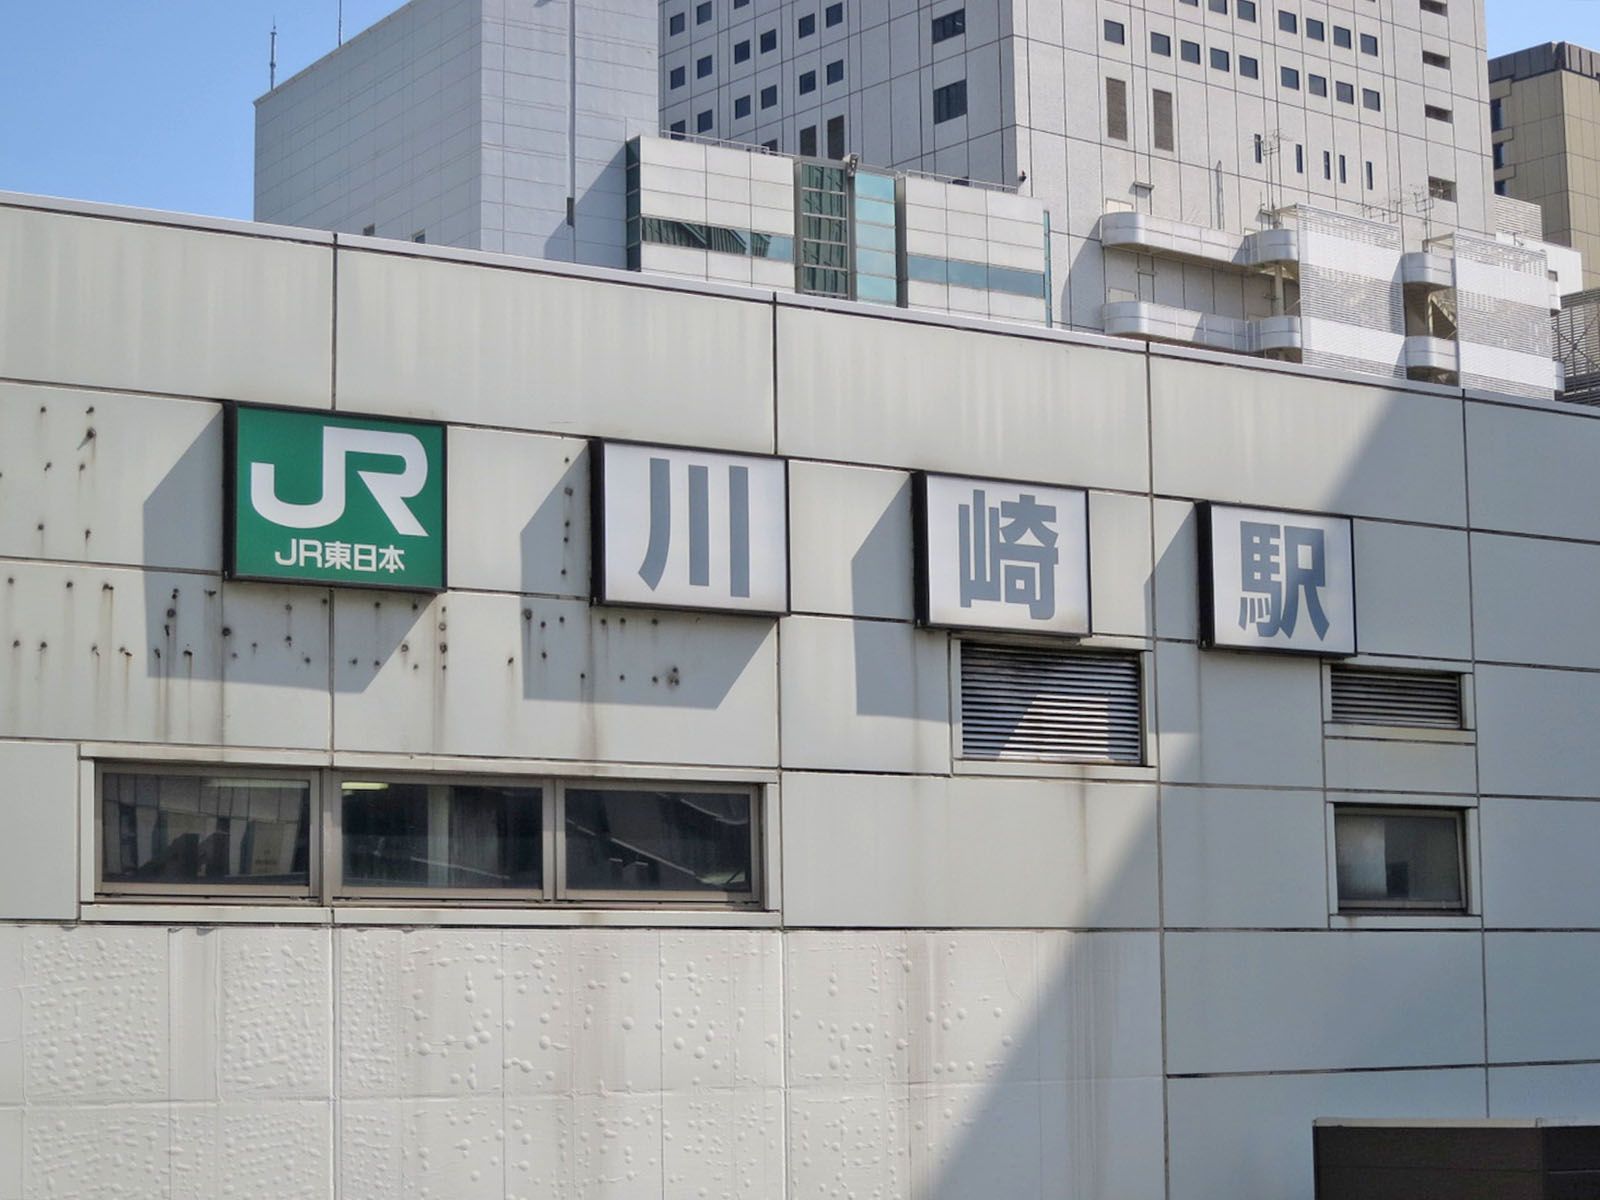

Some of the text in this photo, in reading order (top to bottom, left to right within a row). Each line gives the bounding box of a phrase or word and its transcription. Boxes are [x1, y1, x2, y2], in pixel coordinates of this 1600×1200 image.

[251, 426, 429, 536] JR
[275, 538, 405, 573] JR東日本
